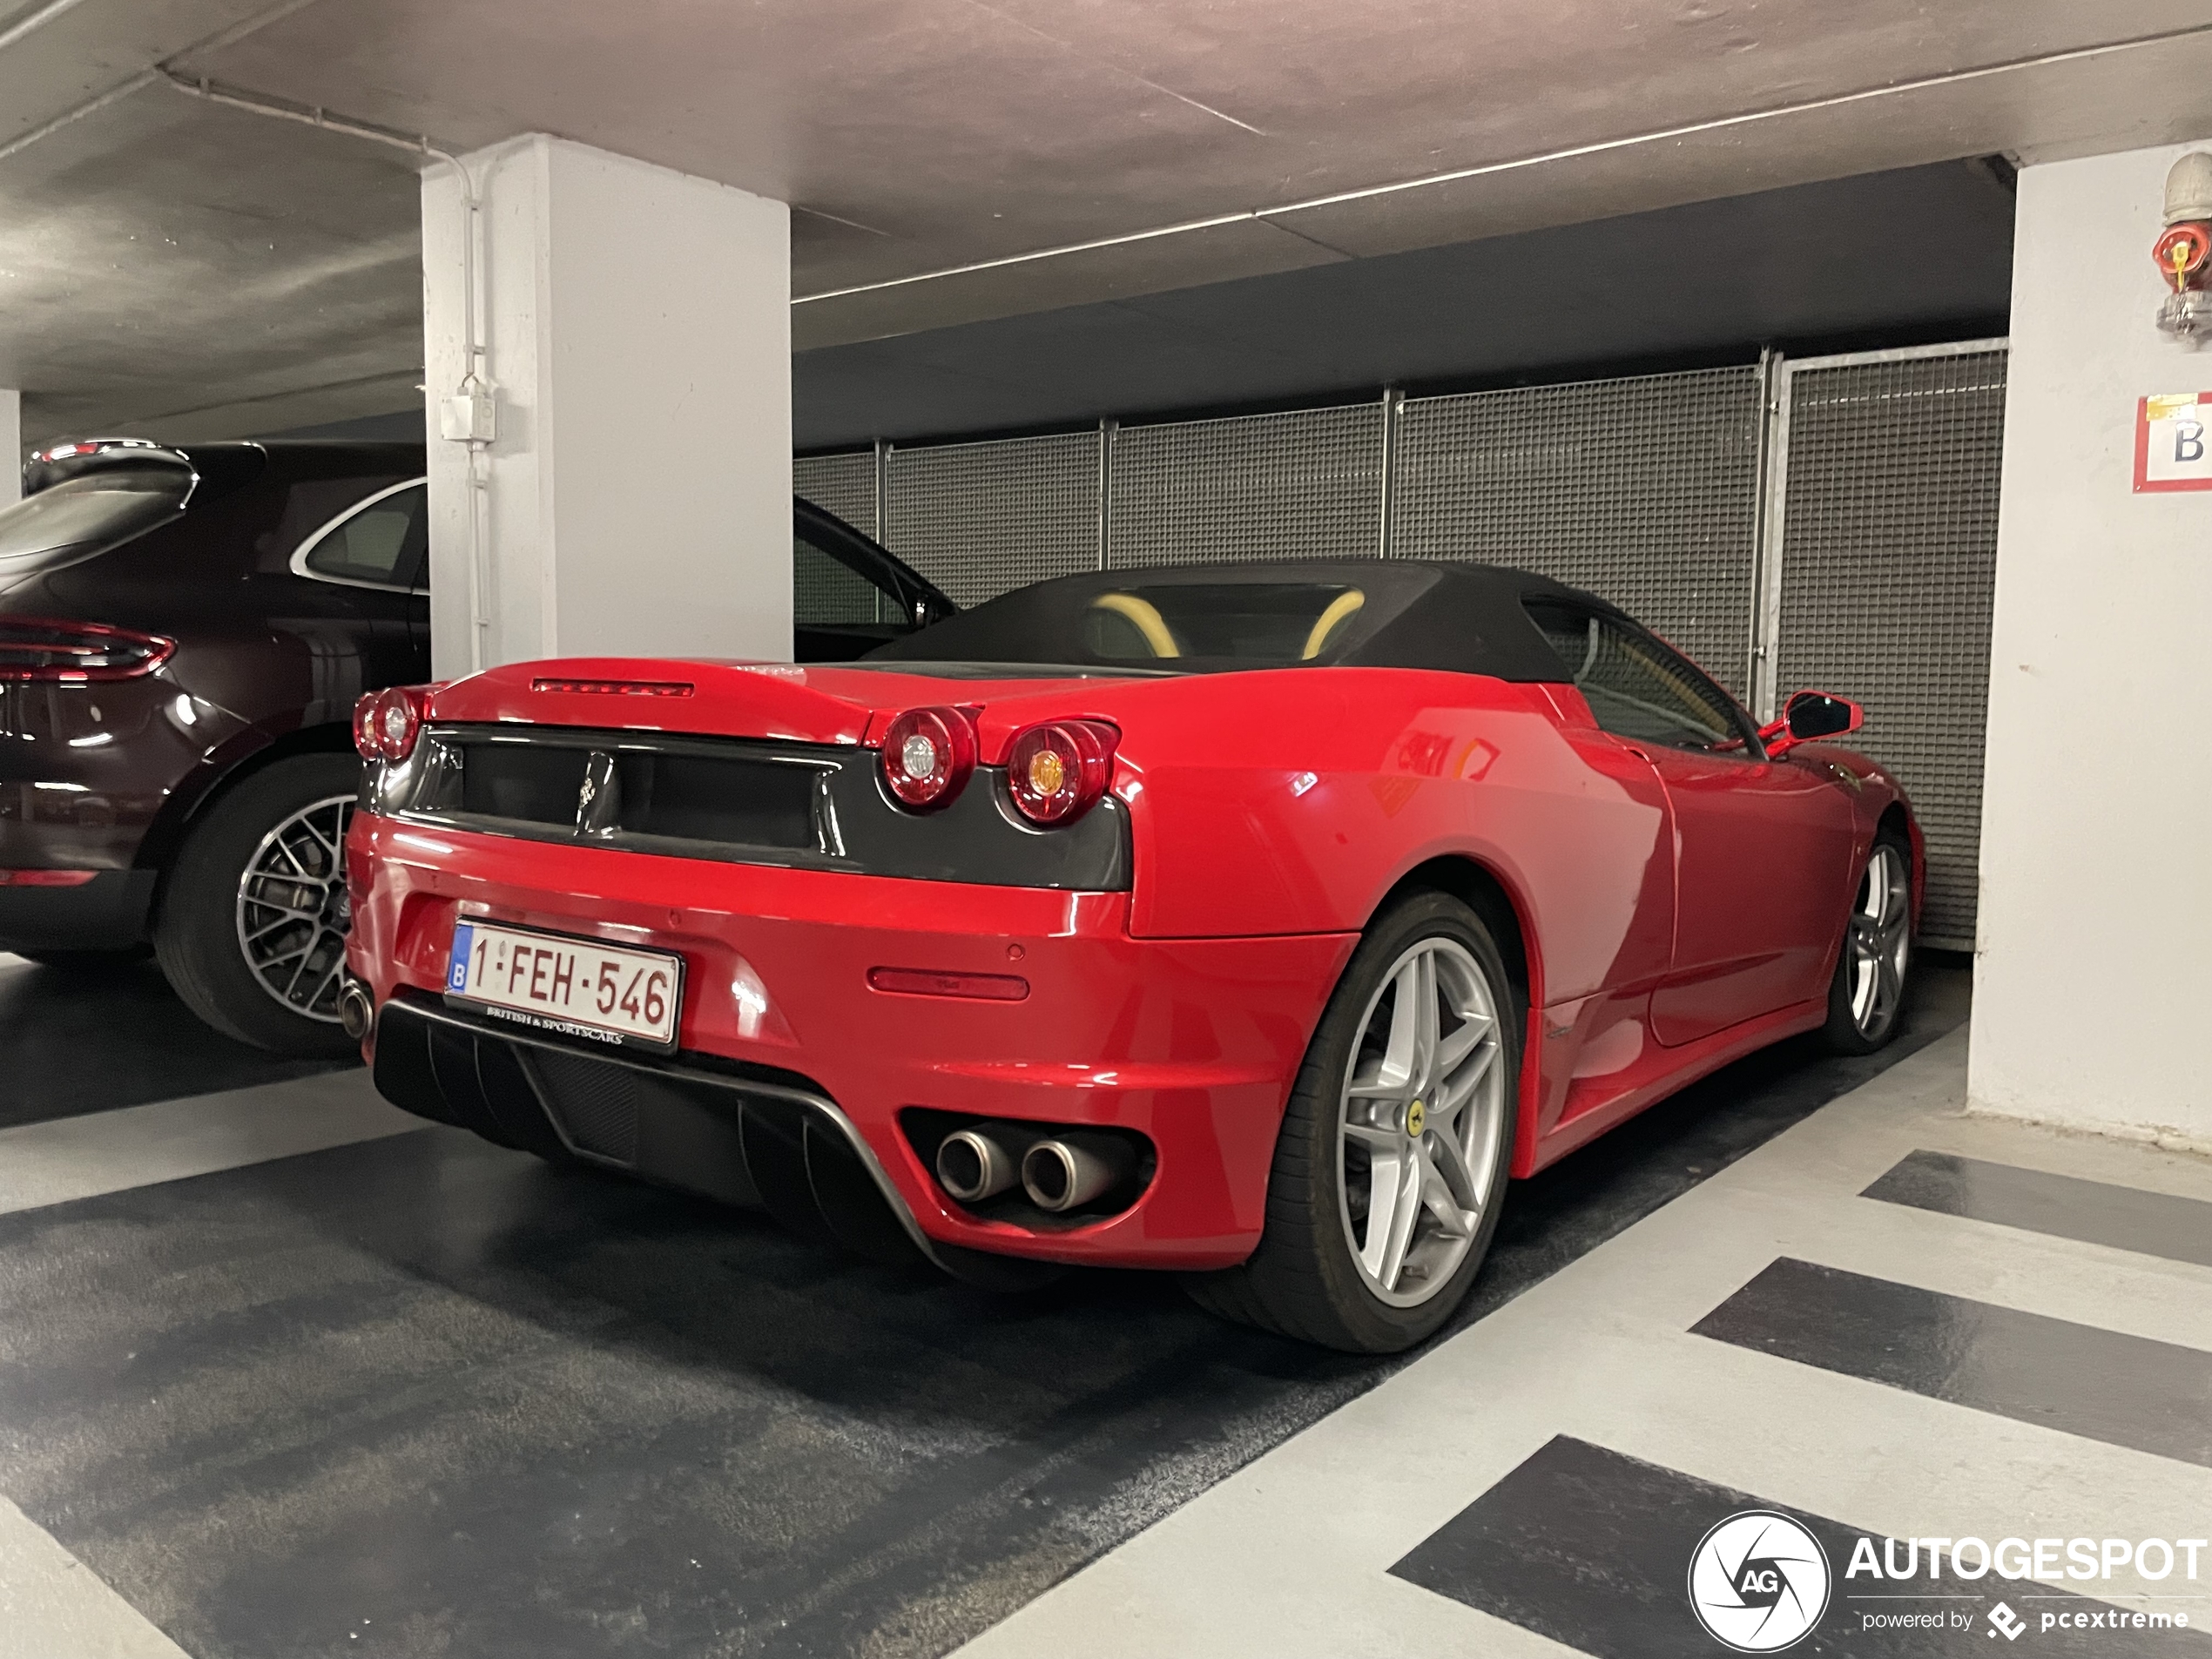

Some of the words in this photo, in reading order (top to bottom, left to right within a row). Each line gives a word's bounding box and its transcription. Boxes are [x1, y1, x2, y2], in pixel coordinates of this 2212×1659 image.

[2175, 421, 2204, 462] B
[453, 963, 466, 988] B
[487, 1006, 532, 1025] BRITISH
[533, 1016, 542, 1027] &
[543, 1018, 624, 1045] SPORTSCARS
